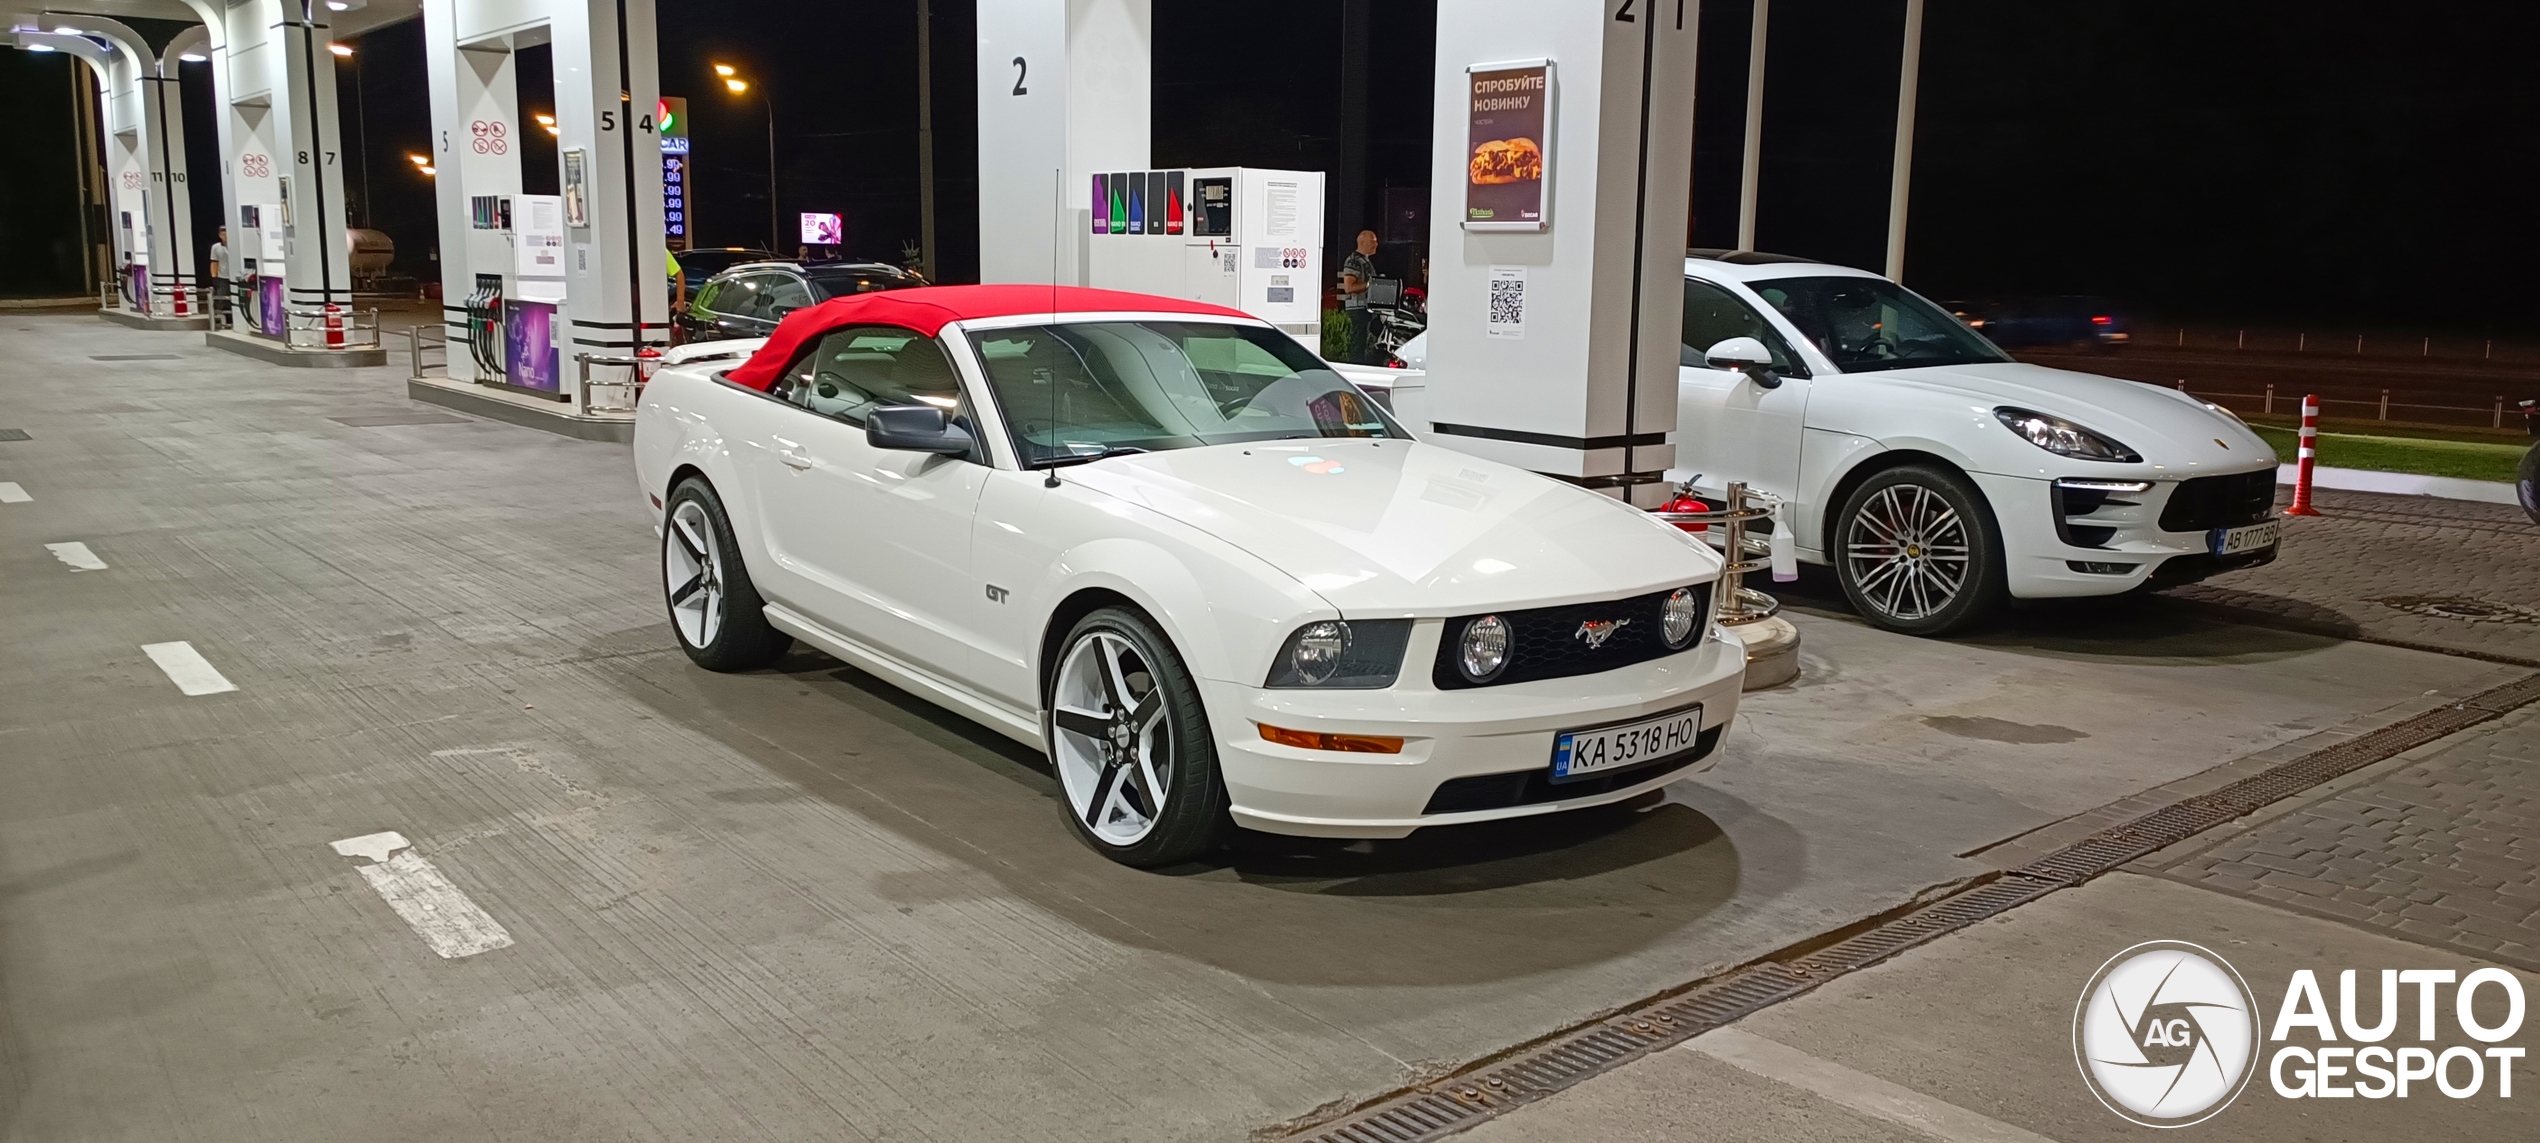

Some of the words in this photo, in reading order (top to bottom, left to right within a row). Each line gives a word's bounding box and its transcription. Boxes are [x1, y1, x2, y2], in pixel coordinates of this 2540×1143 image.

[1012, 56, 1027, 96] 2
[1474, 75, 1544, 94] СПРОБУЙТЕ
[1474, 96, 1531, 112] НОВИНКУ
[601, 111, 615, 131] 5
[639, 114, 654, 134] 4
[443, 131, 448, 152] 5
[298, 151, 309, 164] 8
[325, 152, 336, 165] 7
[662, 159, 680, 169] .99
[151, 172, 163, 182] 11
[171, 173, 185, 182] 10
[664, 172, 681, 182] .99
[663, 186, 682, 195] .99
[664, 198, 682, 208] .99
[664, 212, 682, 221] .99
[518, 361, 535, 378] Nano
[2226, 532, 2242, 550] AB
[2244, 528, 2264, 547] 1777
[986, 584, 1009, 605] GT
[1573, 737, 1605, 769] KA
[1613, 726, 1661, 761] 5318
[1665, 718, 1693, 750] HO
[1556, 761, 1568, 771] UA
